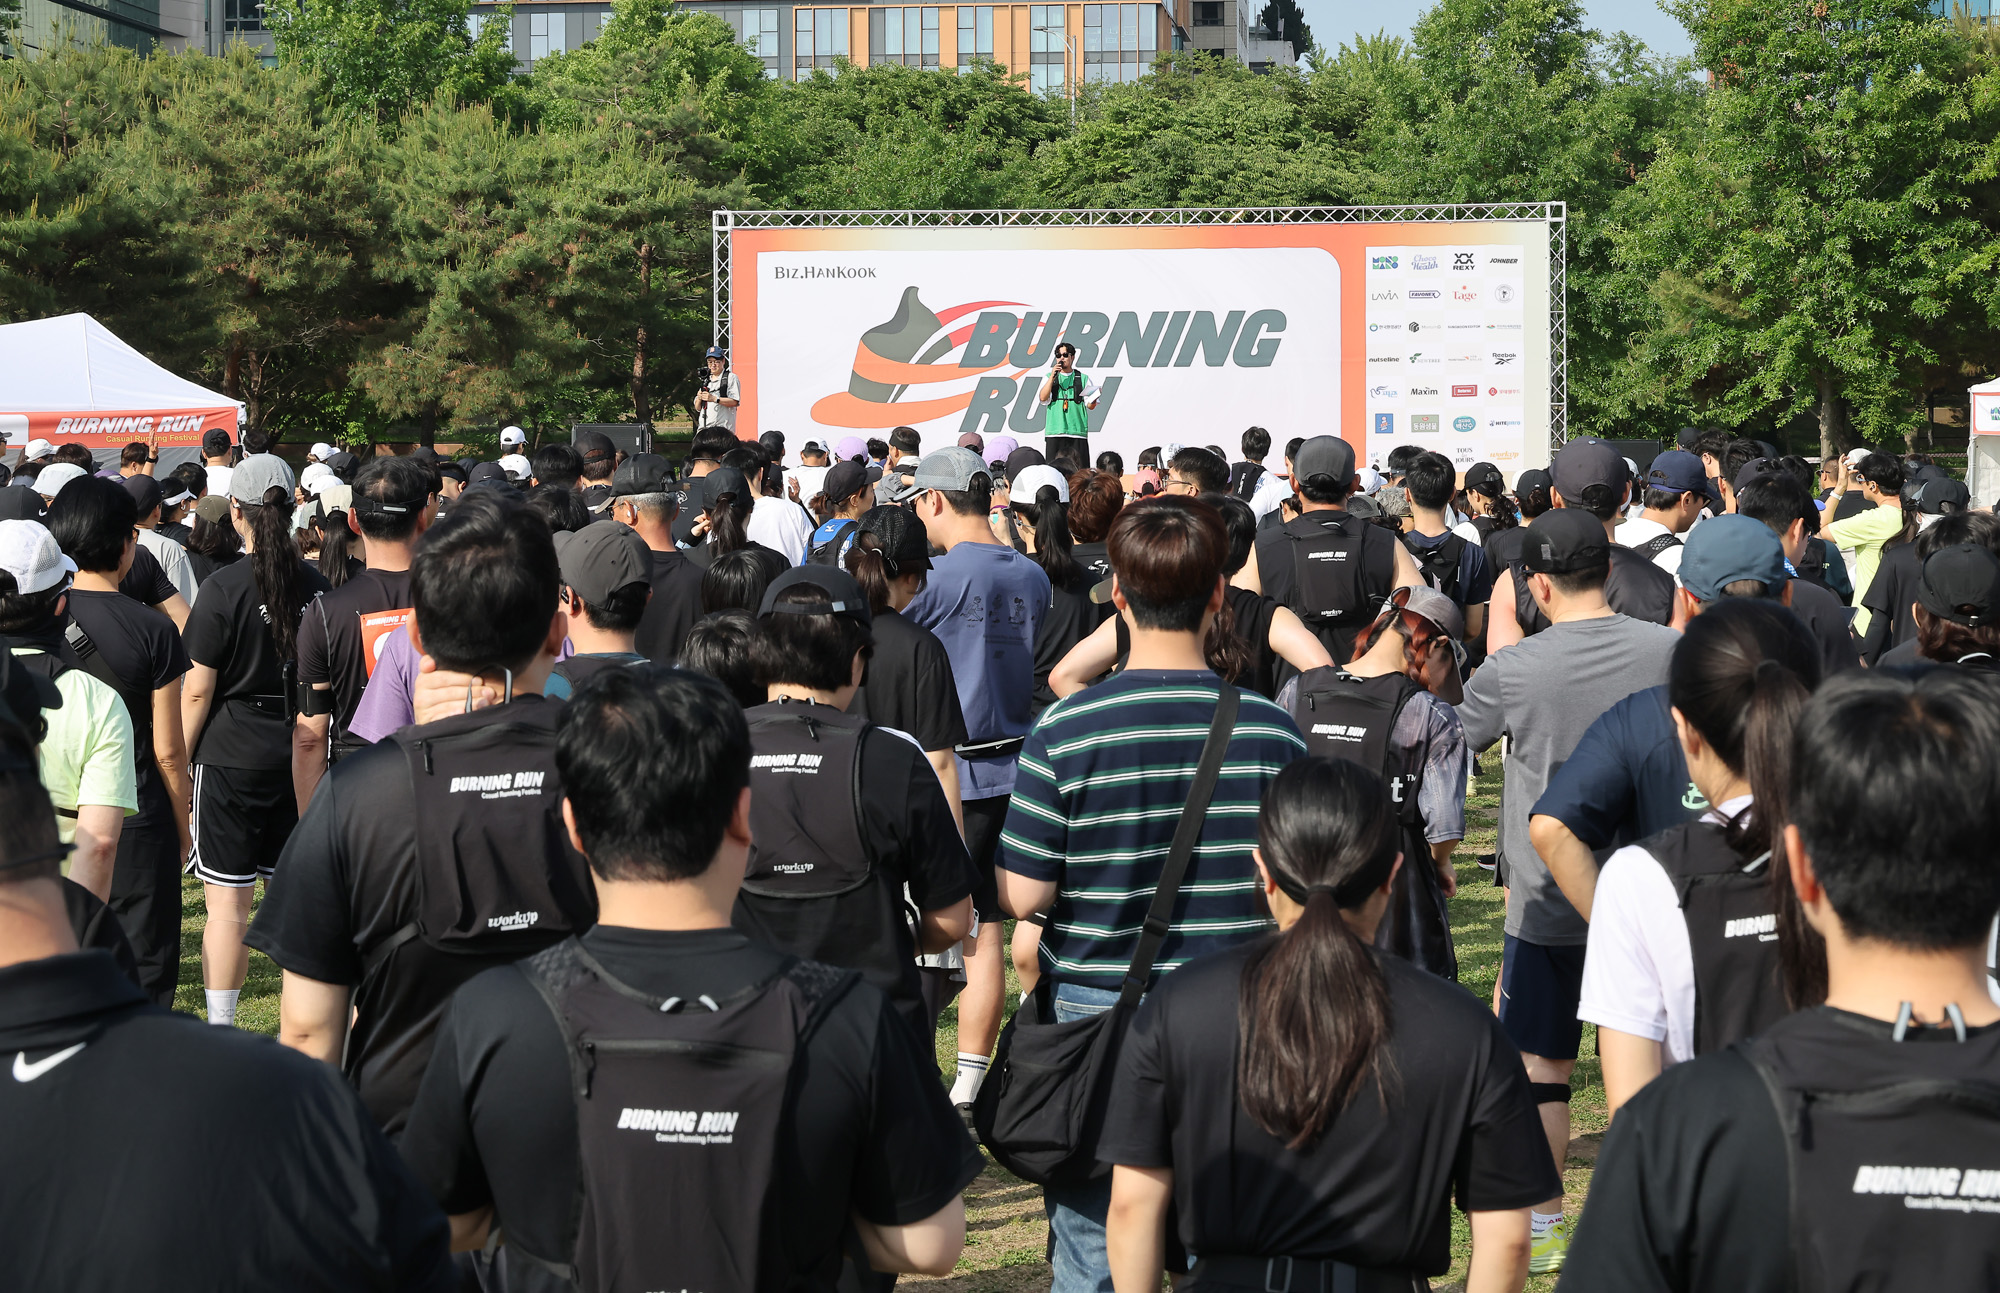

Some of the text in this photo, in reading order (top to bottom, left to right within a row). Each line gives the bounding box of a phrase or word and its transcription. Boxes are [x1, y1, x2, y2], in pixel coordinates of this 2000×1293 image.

[1411, 260, 1439, 271] Health
[1413, 254, 1437, 262] Choco
[958, 309, 1287, 369] BURNING
[1410, 387, 1438, 396] Maxim
[55, 414, 206, 434] BURNING RUN
[106, 433, 200, 443] Casual Runing Festival
[1311, 724, 1367, 738] BURNING RUN
[749, 754, 823, 768] BURNING RUN
[449, 771, 545, 793] BURNING RUN
[1724, 913, 1777, 938] BURNI
[616, 1107, 740, 1133] BURNING RUN
[1852, 1165, 1962, 1196] BURNING
